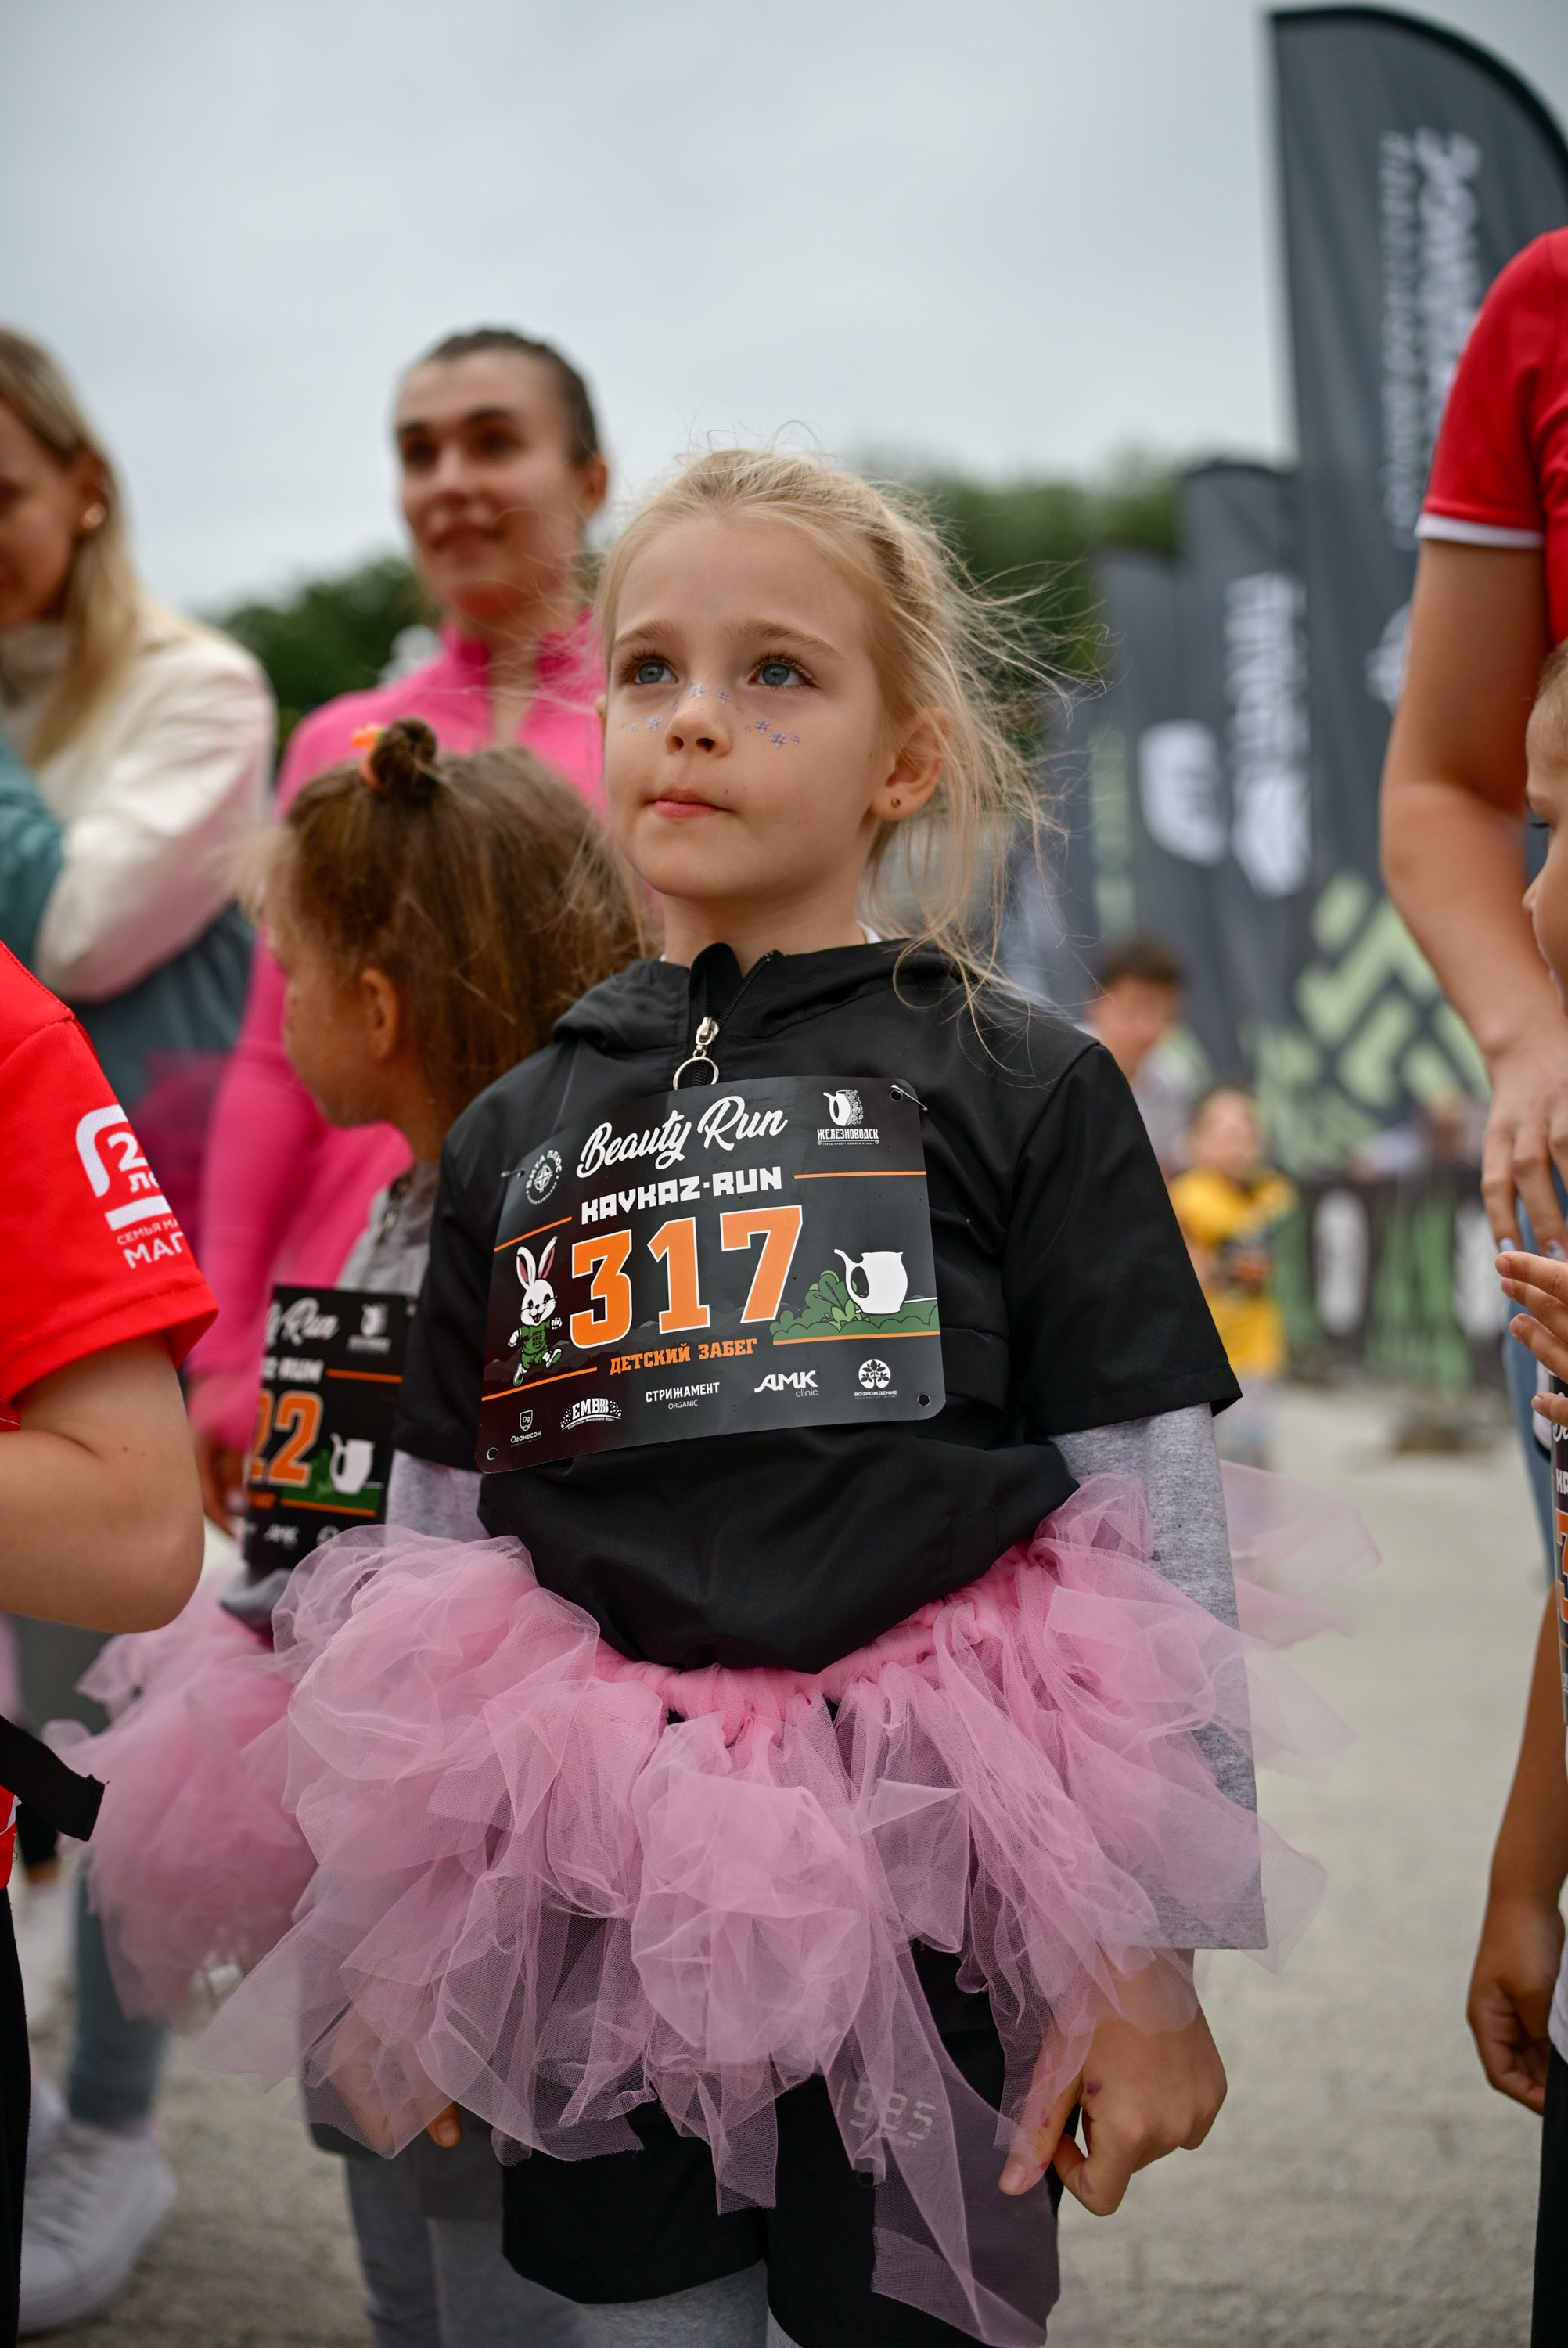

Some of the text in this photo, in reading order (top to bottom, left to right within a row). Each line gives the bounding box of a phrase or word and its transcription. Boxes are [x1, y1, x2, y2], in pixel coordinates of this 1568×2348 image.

[577, 1096, 789, 1179] Beauty Run
[817, 1129, 879, 1140] ЖЕЛЕЗНОВОДСК
[117, 1223, 161, 1246] СЕМЬЯ
[569, 1204, 804, 1349] 317
[610, 1338, 757, 1376] ДЕТСКИЙ ЗАБЕГ
[646, 1381, 721, 1403] СТРИЖАМЕНТ
[795, 1388, 818, 1398] clinic
[667, 1399, 698, 1410] ORGANIC
